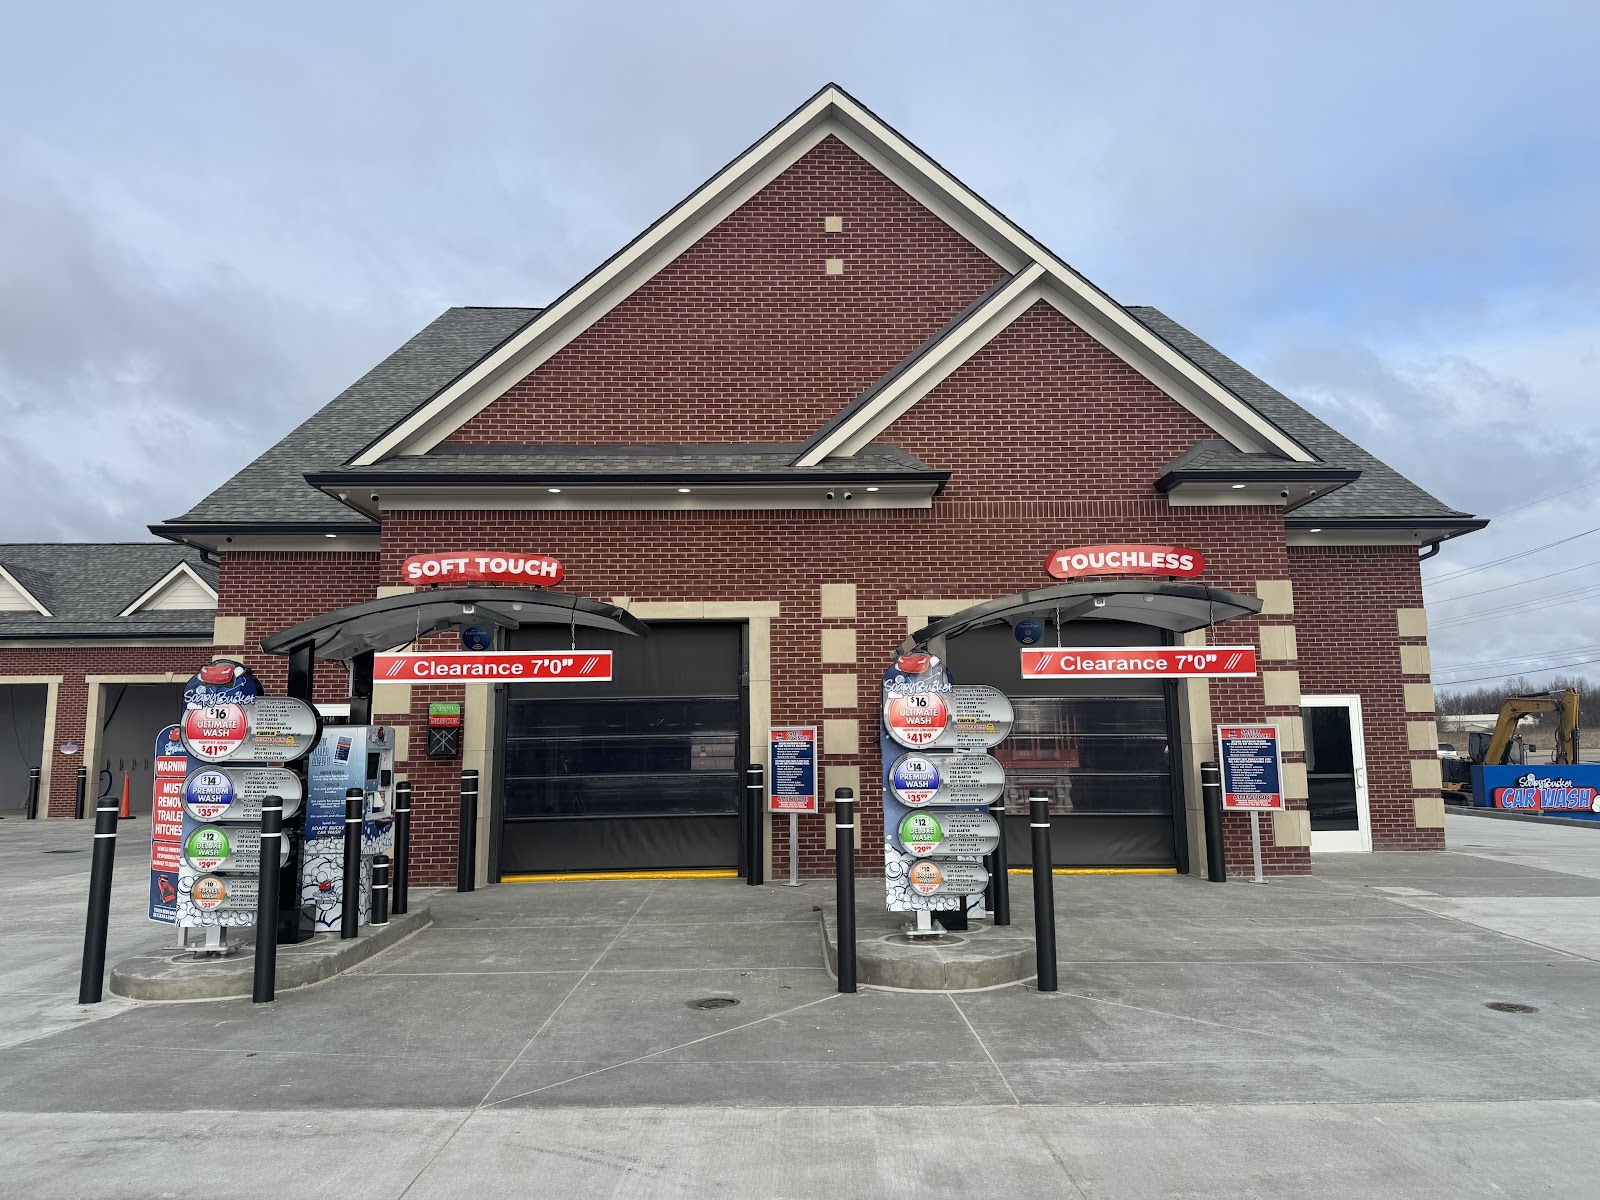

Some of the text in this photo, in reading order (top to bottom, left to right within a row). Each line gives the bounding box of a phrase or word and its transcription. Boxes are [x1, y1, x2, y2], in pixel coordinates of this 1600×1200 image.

[408, 558, 557, 578] SOFT TOUCH
[1056, 551, 1193, 572] TOUCHLESS
[413, 659, 573, 676] Clearance 7'0"
[1060, 654, 1217, 671] Clearance 7'0"
[884, 679, 953, 696] Soapy Bucket
[184, 690, 256, 707] Soapy Bucket
[911, 697, 926, 706] $16
[210, 709, 226, 719] $16
[197, 721, 237, 729] ULTIMATE
[910, 763, 921, 771] $14
[203, 777, 216, 785] $14
[1519, 776, 1573, 789] Soapy Bucket
[164, 783, 182, 794] MUST
[158, 796, 182, 808] REMOV
[1502, 788, 1591, 808] CAR WASH
[155, 823, 182, 836] HITCHES
